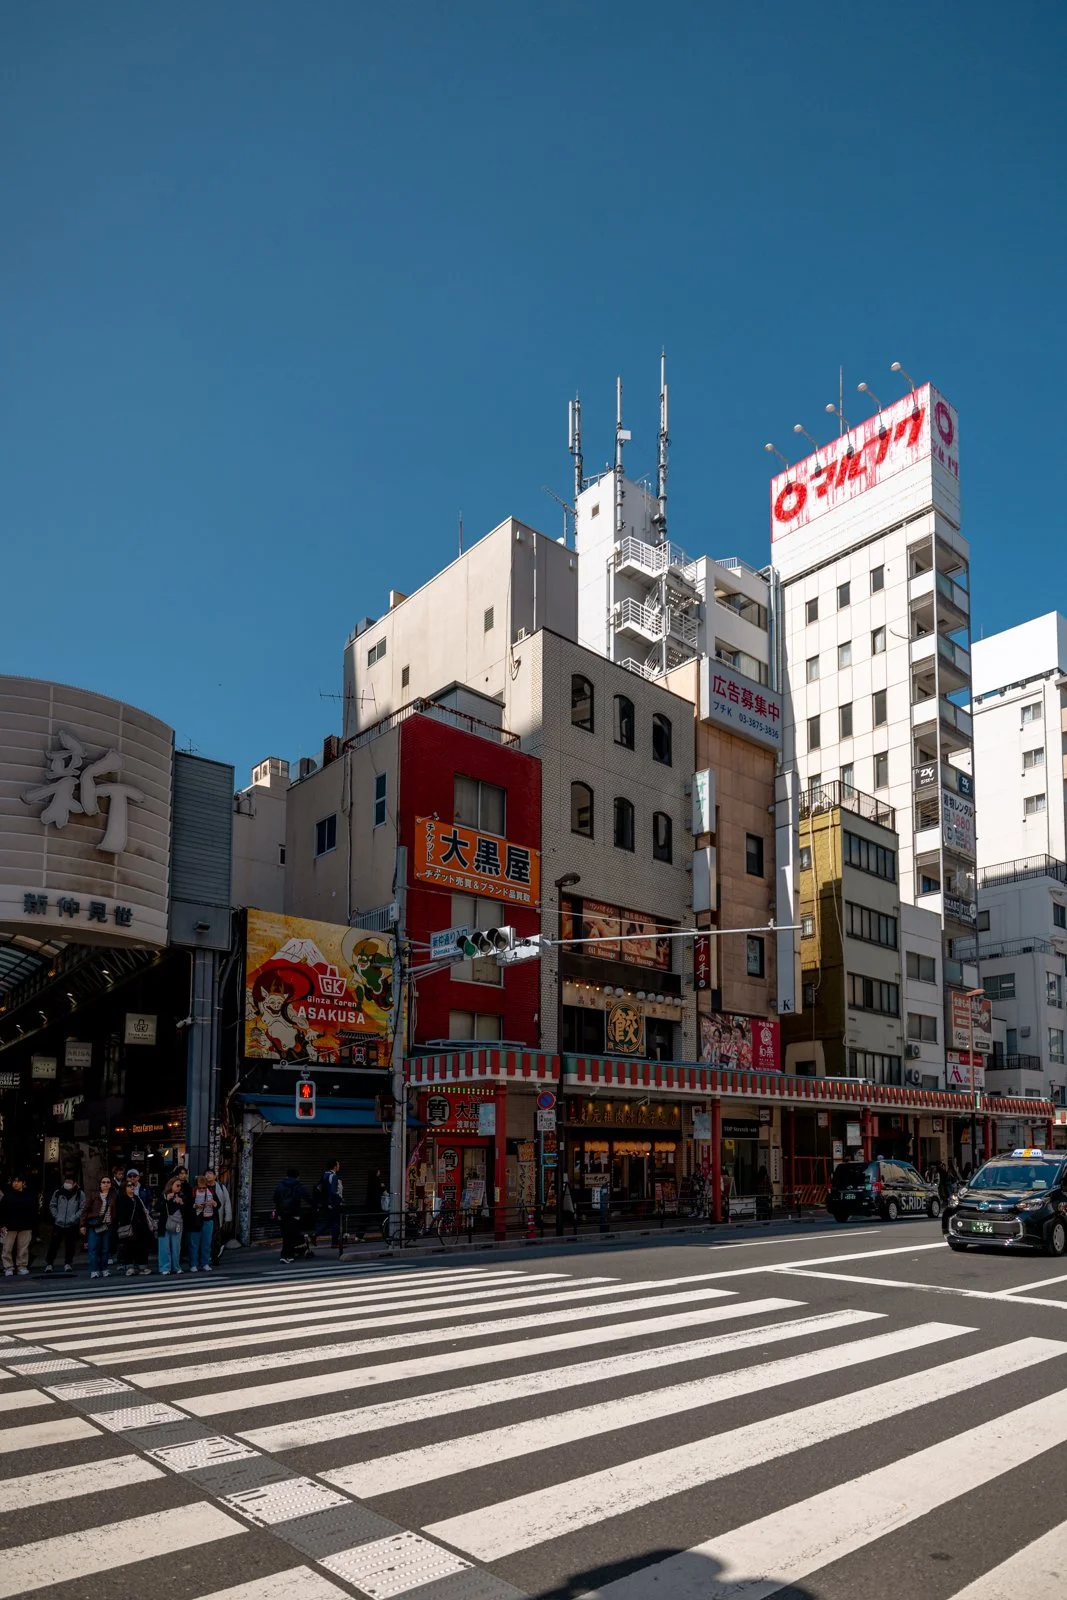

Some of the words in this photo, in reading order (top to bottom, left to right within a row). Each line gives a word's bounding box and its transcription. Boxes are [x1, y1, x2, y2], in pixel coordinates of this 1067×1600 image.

[712, 675, 780, 722] 広告募集中
[943, 793, 974, 818] 着物レンタル
[426, 822, 434, 862] チケット
[440, 827, 531, 885] 大黒屋
[23, 892, 133, 928] 新仲見世
[307, 995, 331, 1005] Ginza
[333, 998, 357, 1008] Karen
[297, 1006, 366, 1025] ASAKUSA
[427, 1099, 448, 1122] 質
[901, 1196, 927, 1211] S.RIDE
